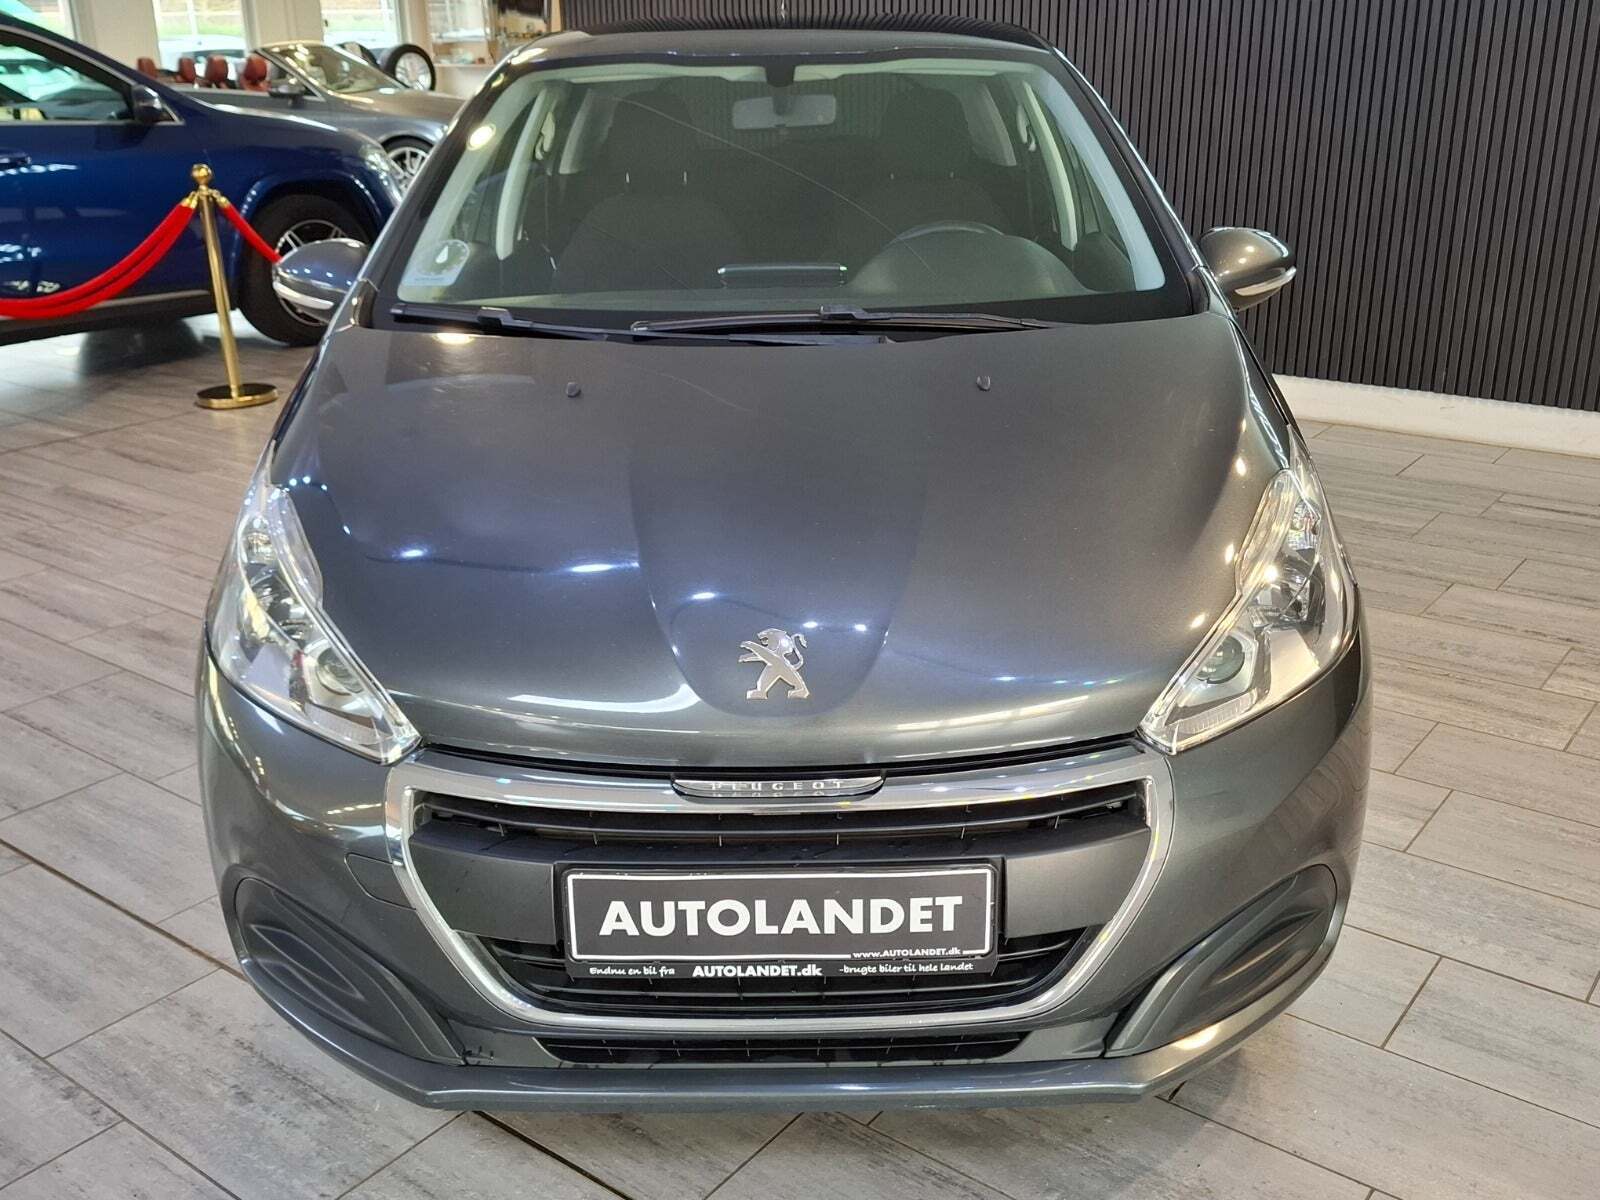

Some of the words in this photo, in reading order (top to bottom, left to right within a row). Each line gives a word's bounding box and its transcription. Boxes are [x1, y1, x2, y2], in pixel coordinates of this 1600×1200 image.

[599, 896, 963, 936] AUTOLANDET
[853, 947, 961, 959] www.AUTOLANDET.dk
[589, 966, 626, 975] Endnu
[643, 966, 657, 975] bil
[659, 966, 675, 977] fra
[692, 964, 823, 977] AUTOLANDET.dk
[879, 963, 902, 973] biler
[904, 962, 916, 972] til
[918, 963, 938, 973] hele
[940, 961, 973, 972] landet
